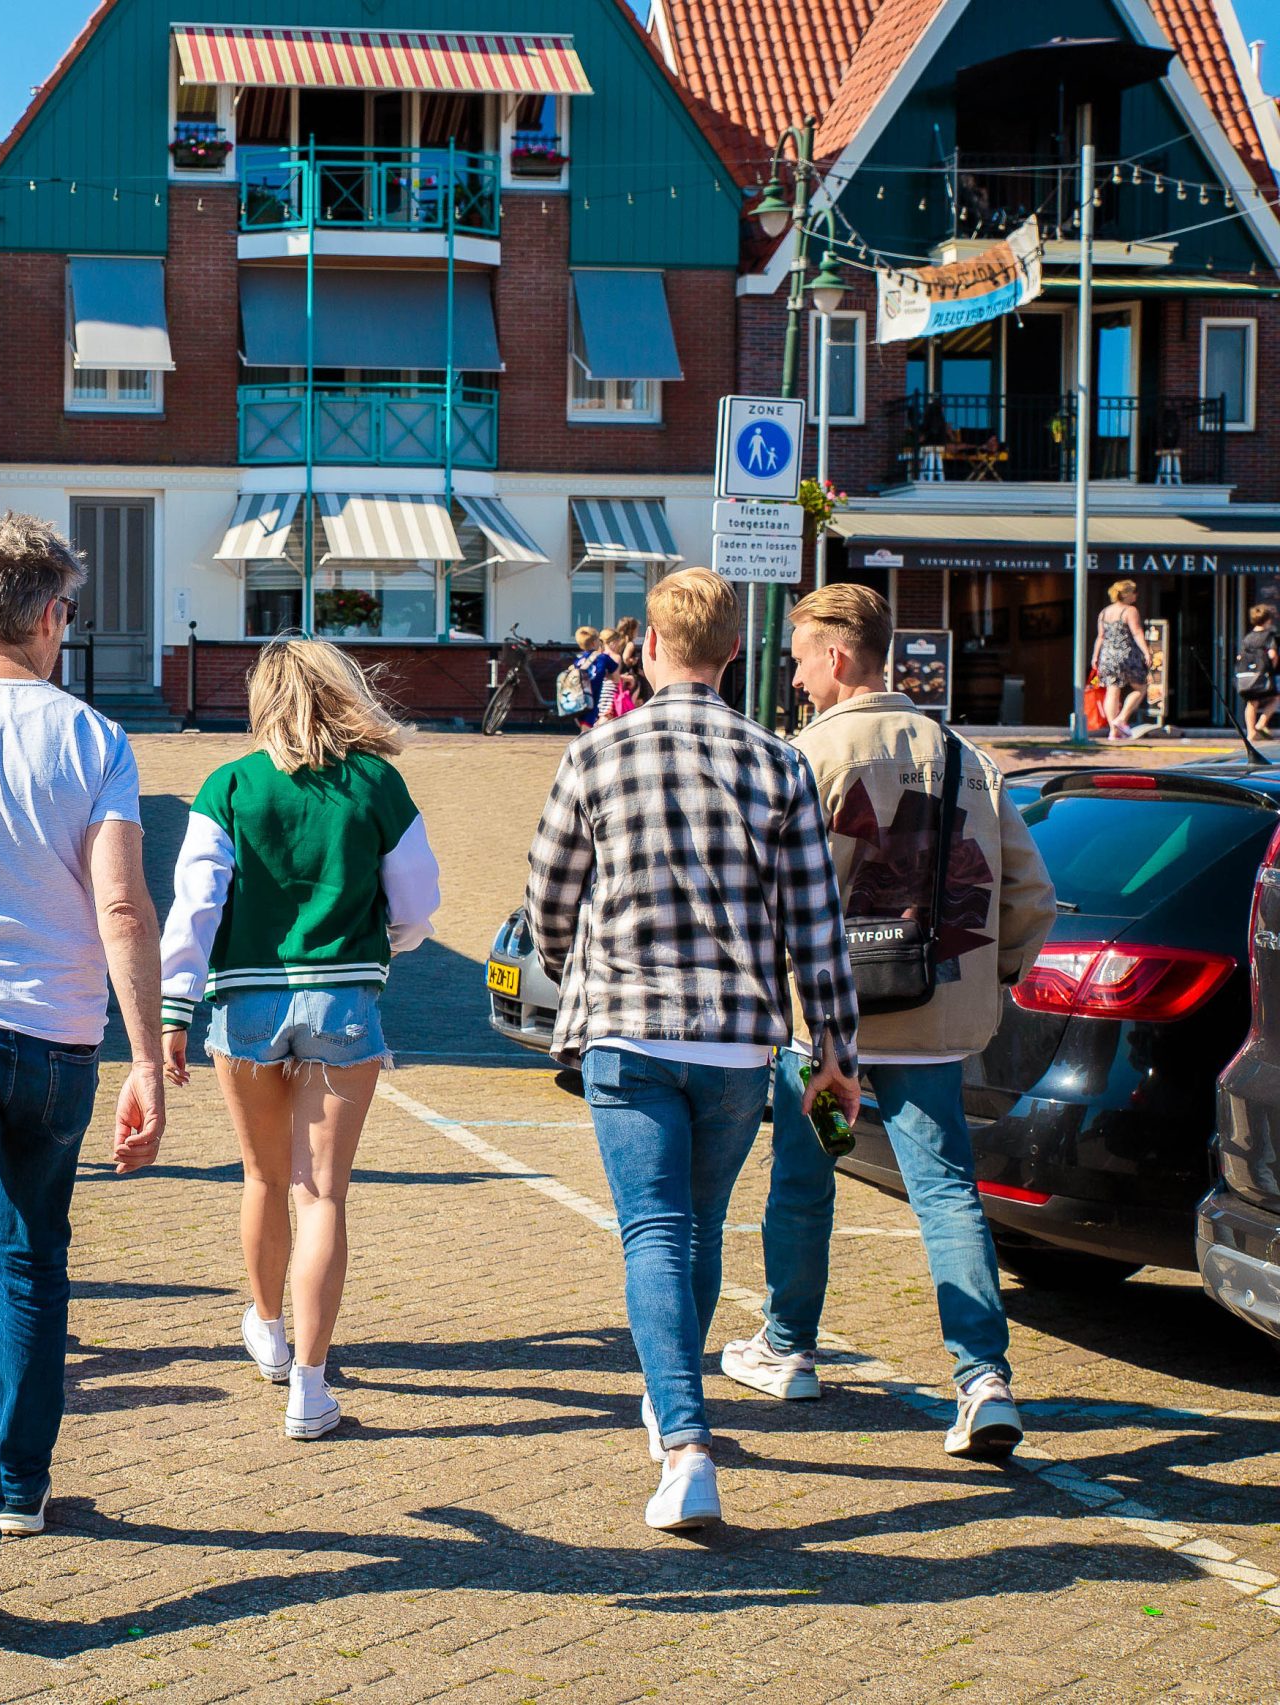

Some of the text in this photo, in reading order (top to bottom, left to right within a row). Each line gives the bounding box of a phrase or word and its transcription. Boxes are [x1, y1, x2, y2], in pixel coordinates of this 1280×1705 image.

[748, 405, 784, 416] ZONE
[741, 505, 779, 517] fietsen
[728, 519, 790, 531] toegestaan
[720, 540, 797, 552] laden en lossen
[726, 554, 791, 567] zon. t/m vrij.
[1064, 553, 1219, 572] DE HAVEN
[718, 567, 777, 578] 06.00-11.00
[899, 771, 1000, 791] IRRELEVT ISSUE
